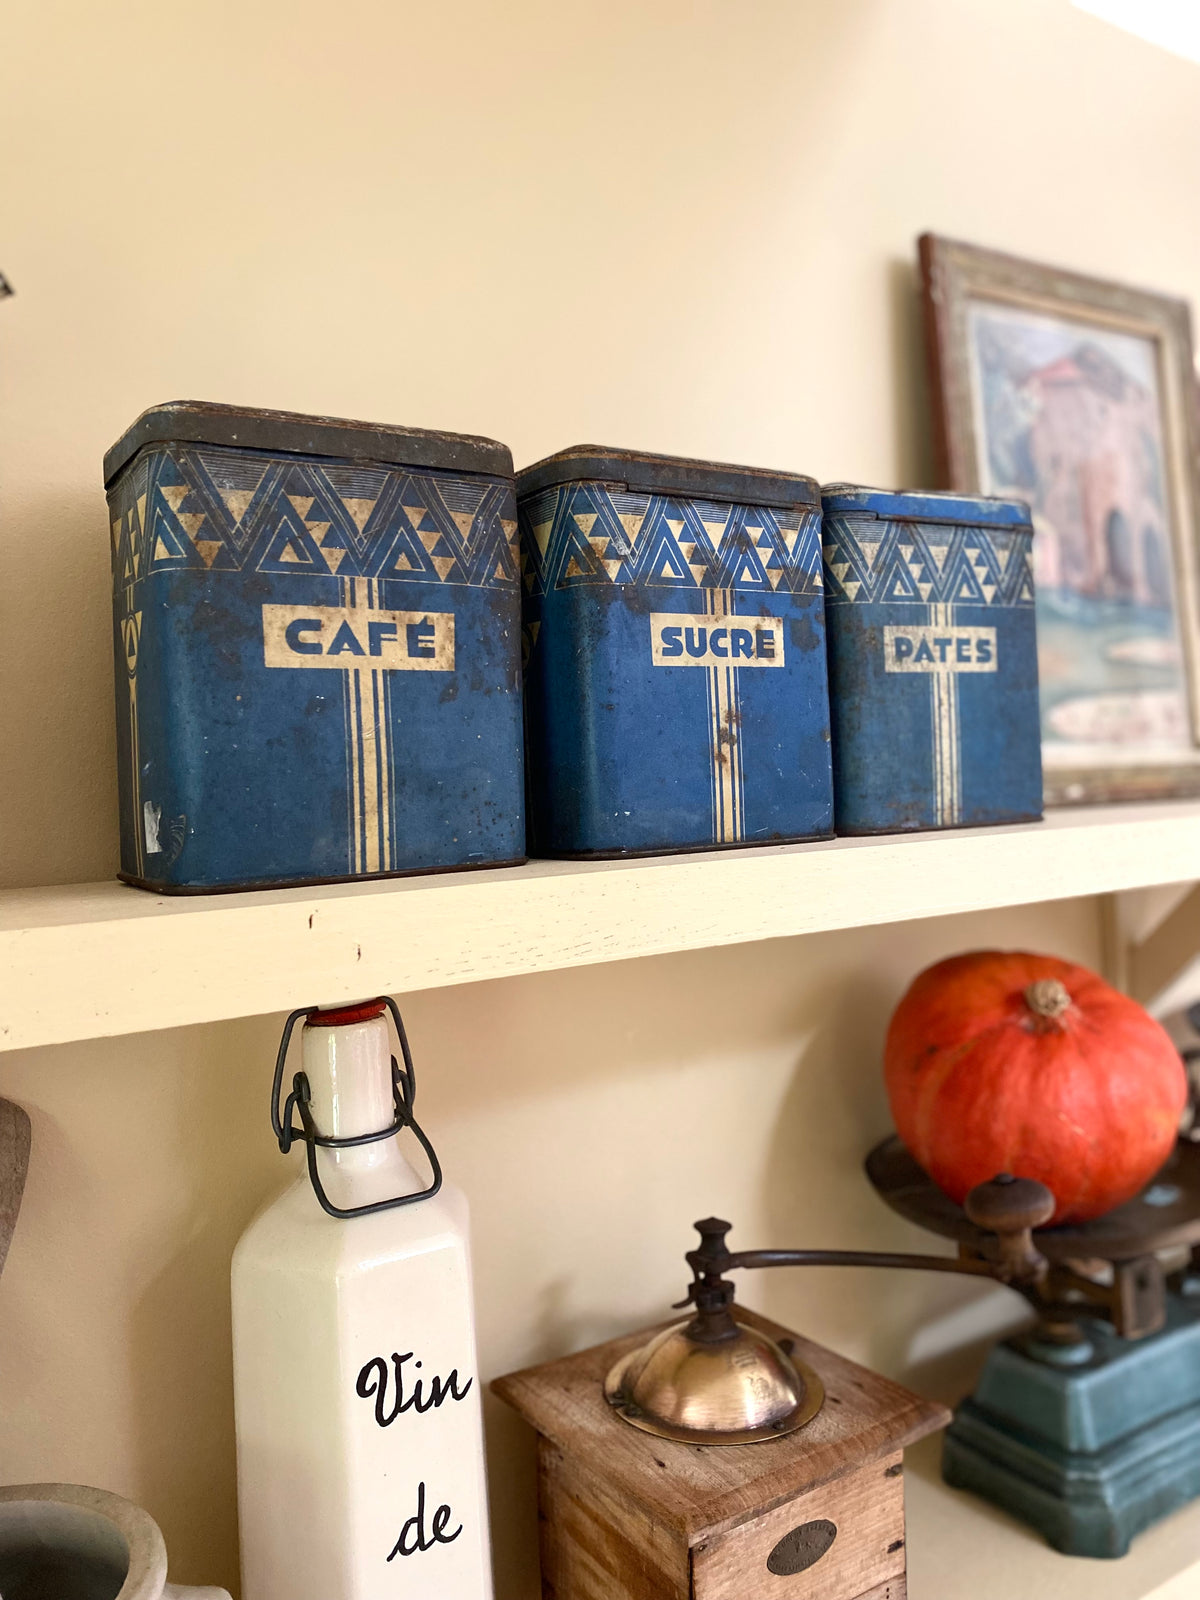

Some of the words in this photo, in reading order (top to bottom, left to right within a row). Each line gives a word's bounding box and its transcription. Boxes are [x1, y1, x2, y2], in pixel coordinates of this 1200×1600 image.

[285, 615, 436, 658] CAFÉ
[660, 626, 775, 659] SUCRE
[355, 1352, 473, 1427] Vin
[386, 1482, 463, 1562] de
